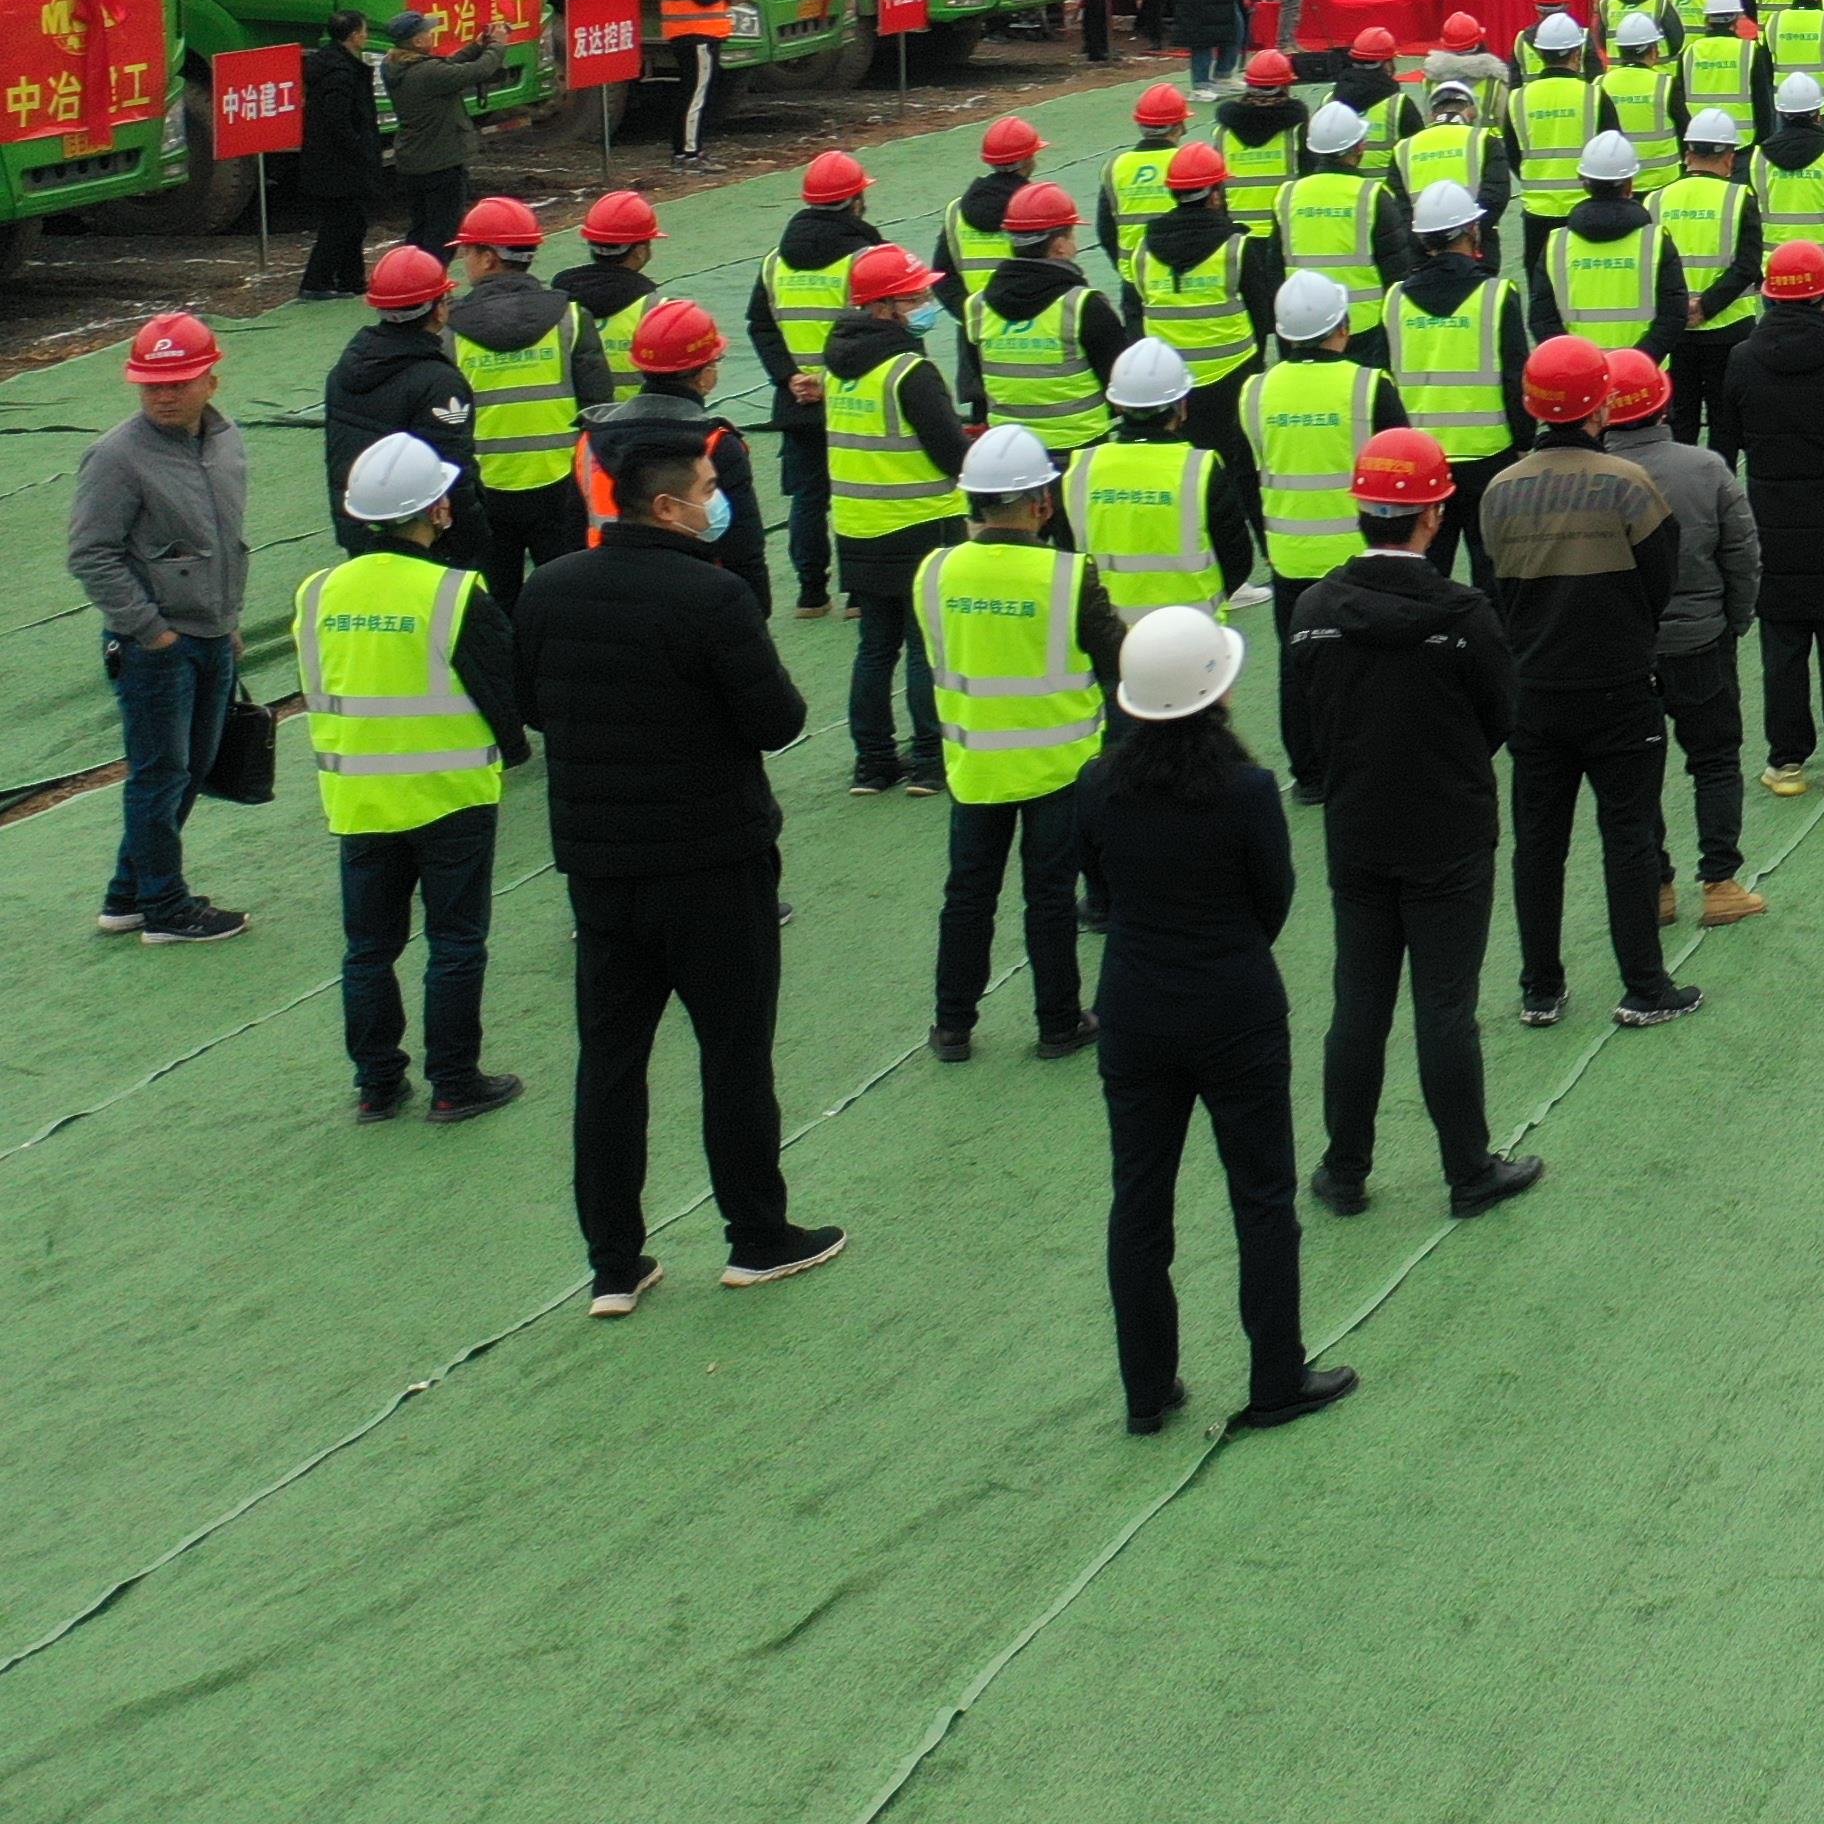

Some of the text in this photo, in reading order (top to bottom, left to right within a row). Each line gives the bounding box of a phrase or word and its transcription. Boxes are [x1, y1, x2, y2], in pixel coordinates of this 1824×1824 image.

[573, 19, 634, 59] 发达控股
[7, 63, 151, 127] 中冶工
[222, 81, 295, 123] 中冶建工
[1266, 412, 1340, 428] 中国中铁五局
[946, 596, 1036, 618] 中国中铁五局
[323, 613, 415, 635] 中国中铁五局
